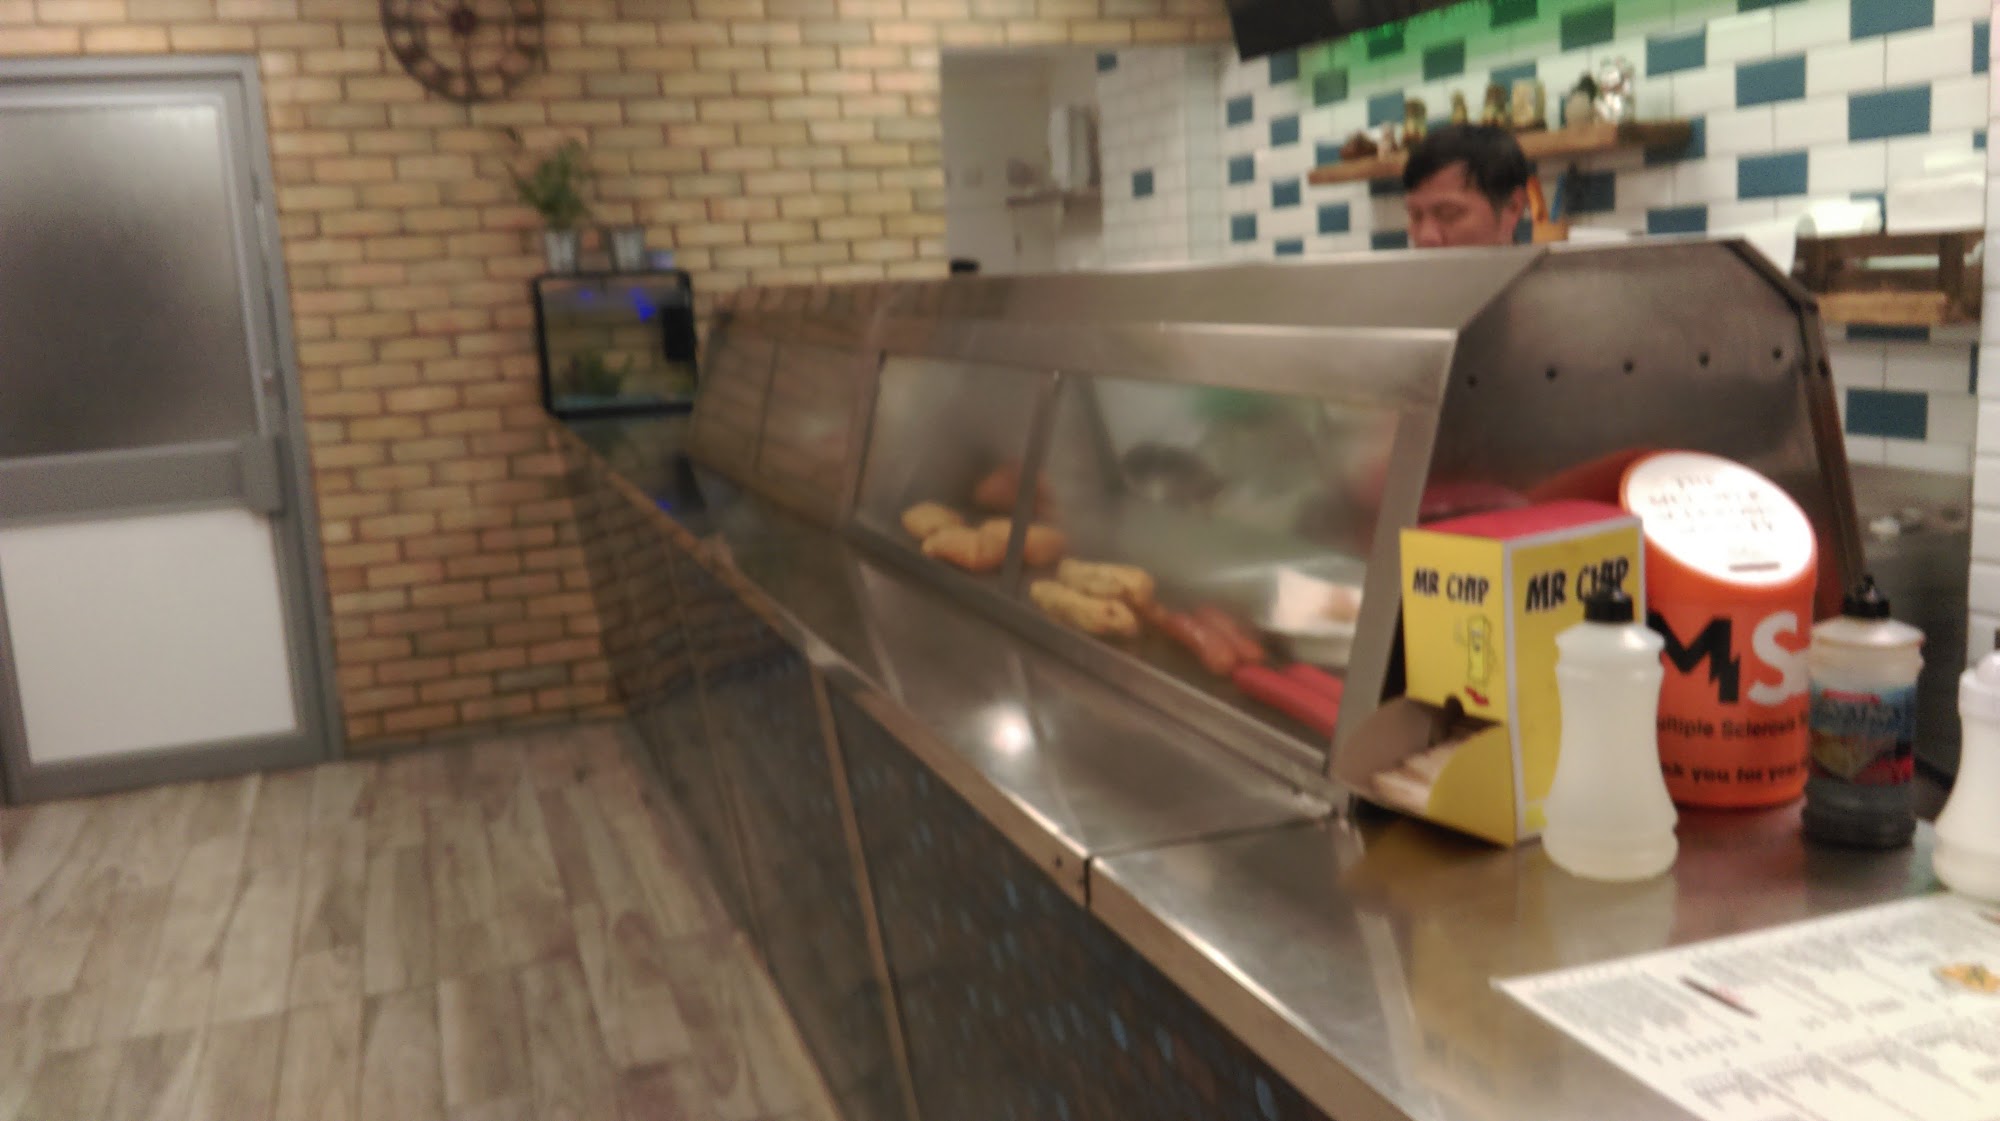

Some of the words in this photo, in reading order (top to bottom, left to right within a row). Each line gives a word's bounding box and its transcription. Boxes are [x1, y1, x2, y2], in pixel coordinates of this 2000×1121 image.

[1413, 567, 1439, 596] MR
[1525, 569, 1567, 612] MR
[1657, 715, 1713, 737] ultiple
